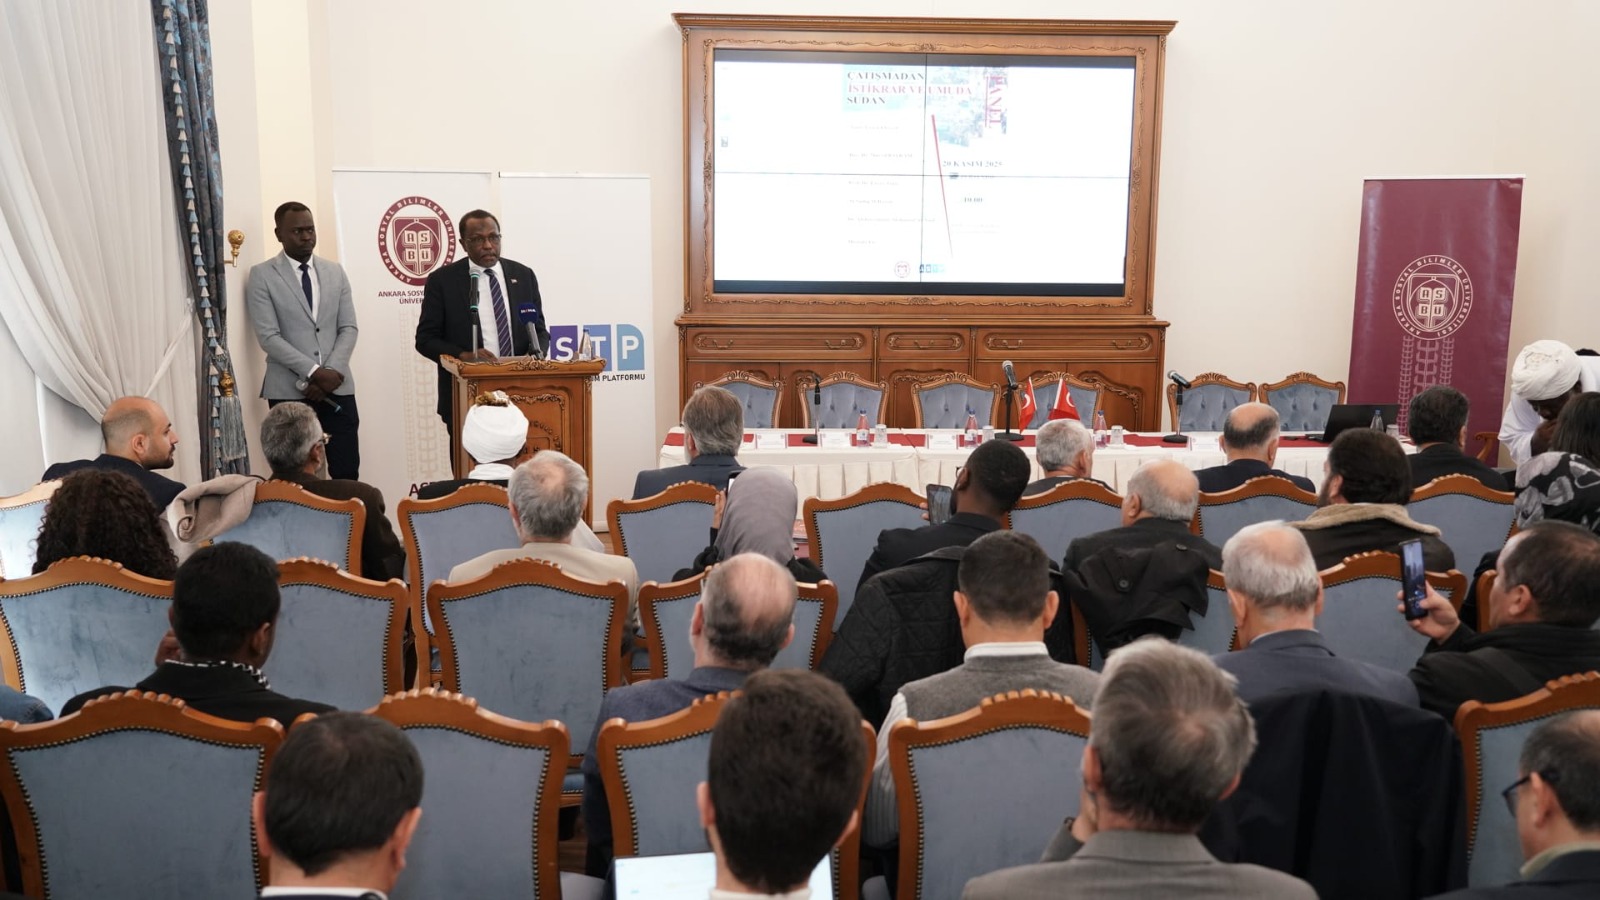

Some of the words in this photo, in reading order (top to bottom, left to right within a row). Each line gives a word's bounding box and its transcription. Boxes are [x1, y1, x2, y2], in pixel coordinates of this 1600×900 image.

[848, 83, 906, 94] İSTİKRAR
[928, 86, 972, 95] UMUDA
[379, 209, 396, 246] SOSYAL
[396, 197, 444, 217] BİLİMLER
[1395, 268, 1414, 301] SOSYAL
[1416, 257, 1463, 275] BİLİMLER
[378, 290, 406, 298] ANKARA
[407, 289, 424, 297] SOSY
[602, 373, 646, 383] PLATFORMU
